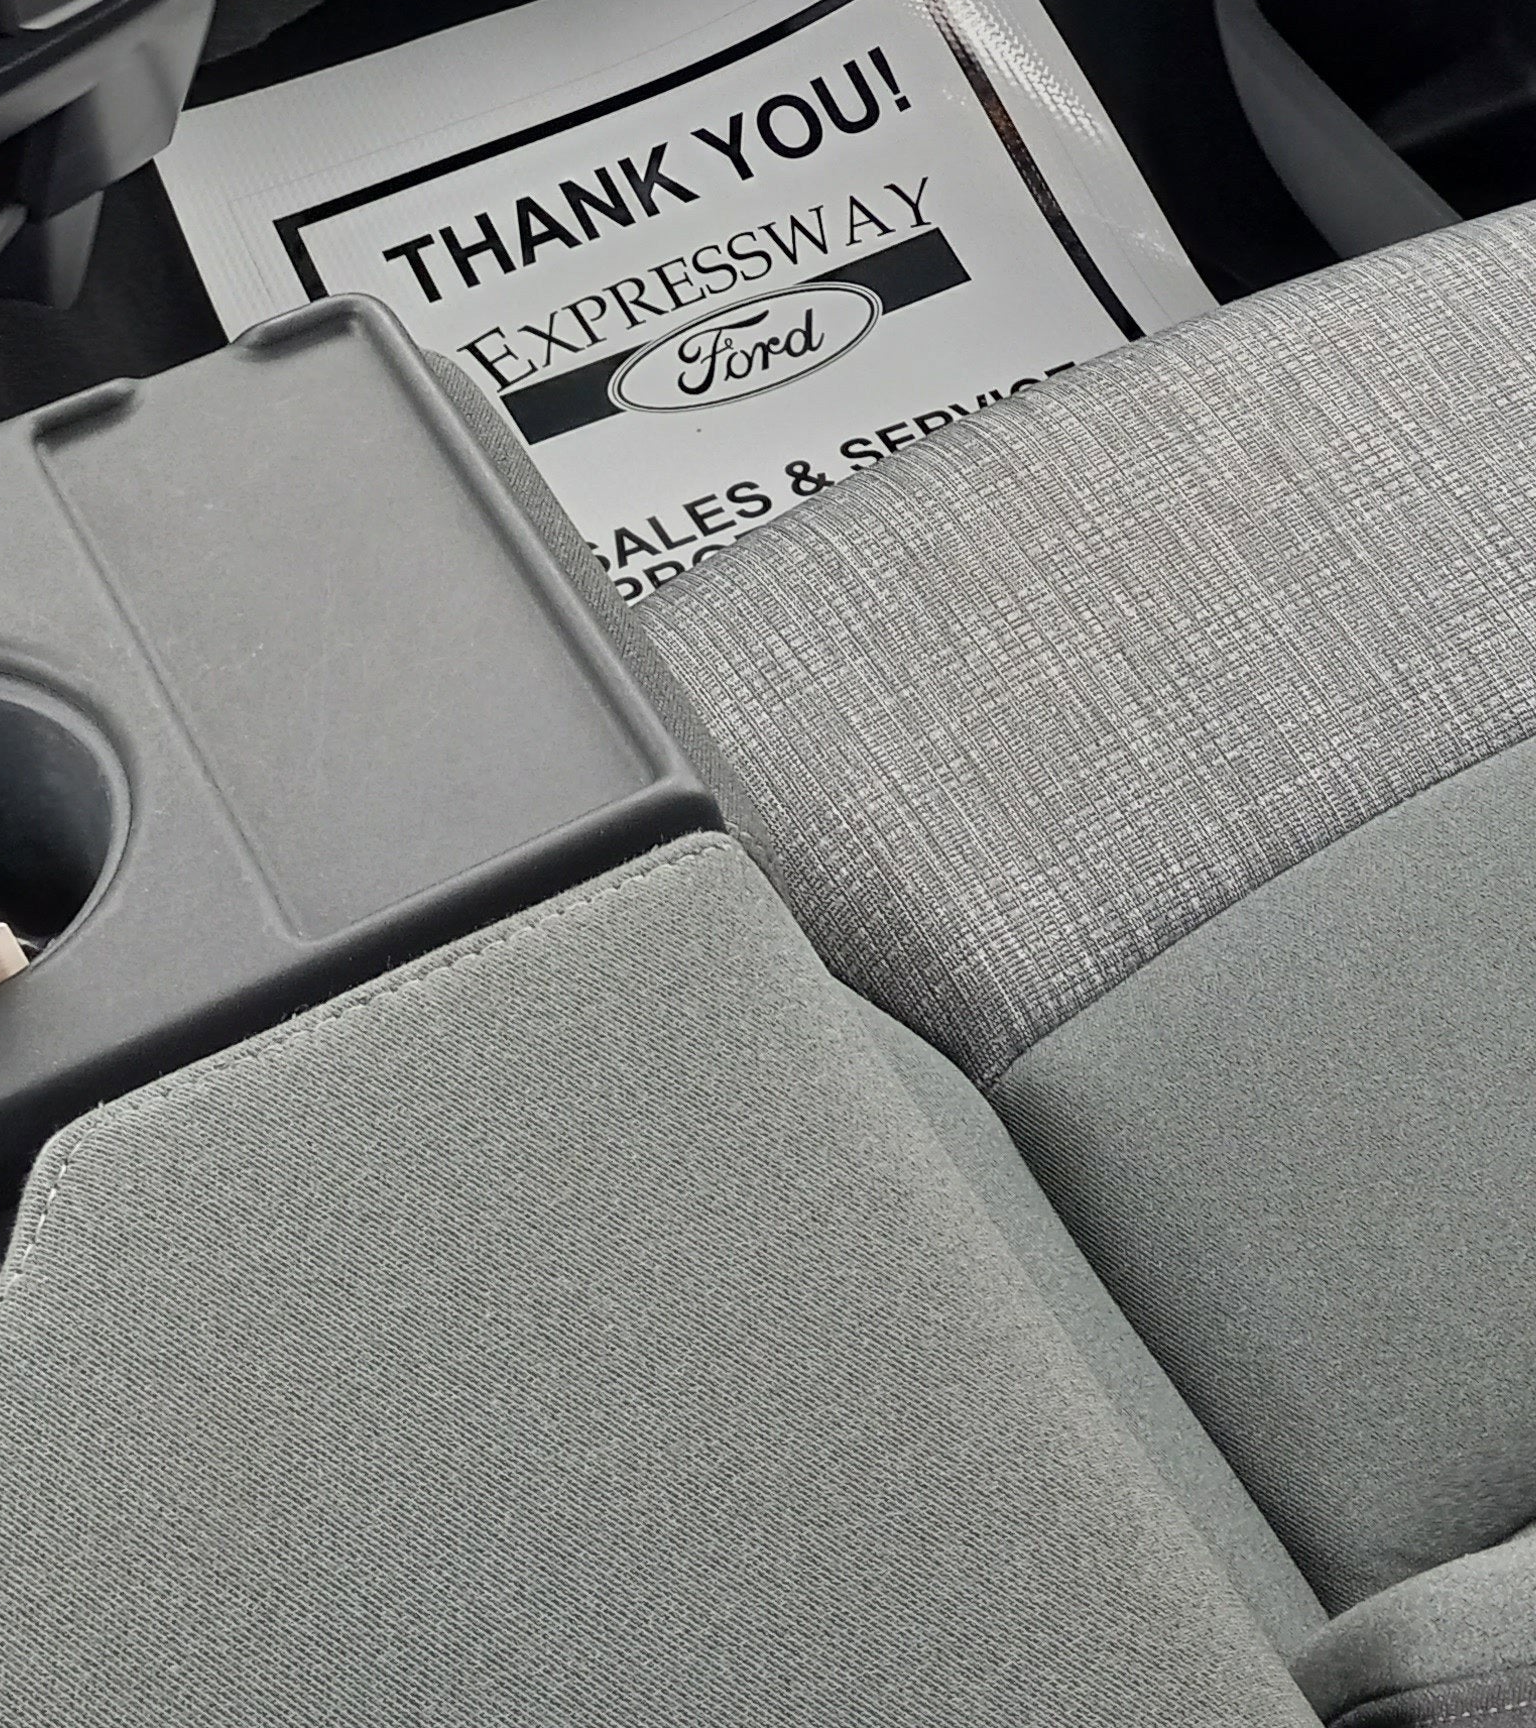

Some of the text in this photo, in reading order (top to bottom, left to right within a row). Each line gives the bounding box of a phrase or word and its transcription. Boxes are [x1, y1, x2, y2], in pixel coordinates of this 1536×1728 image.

[381, 45, 912, 304] THANK YOU!
[456, 176, 937, 393] EXPRESSWAY
[676, 308, 825, 396] Ford
